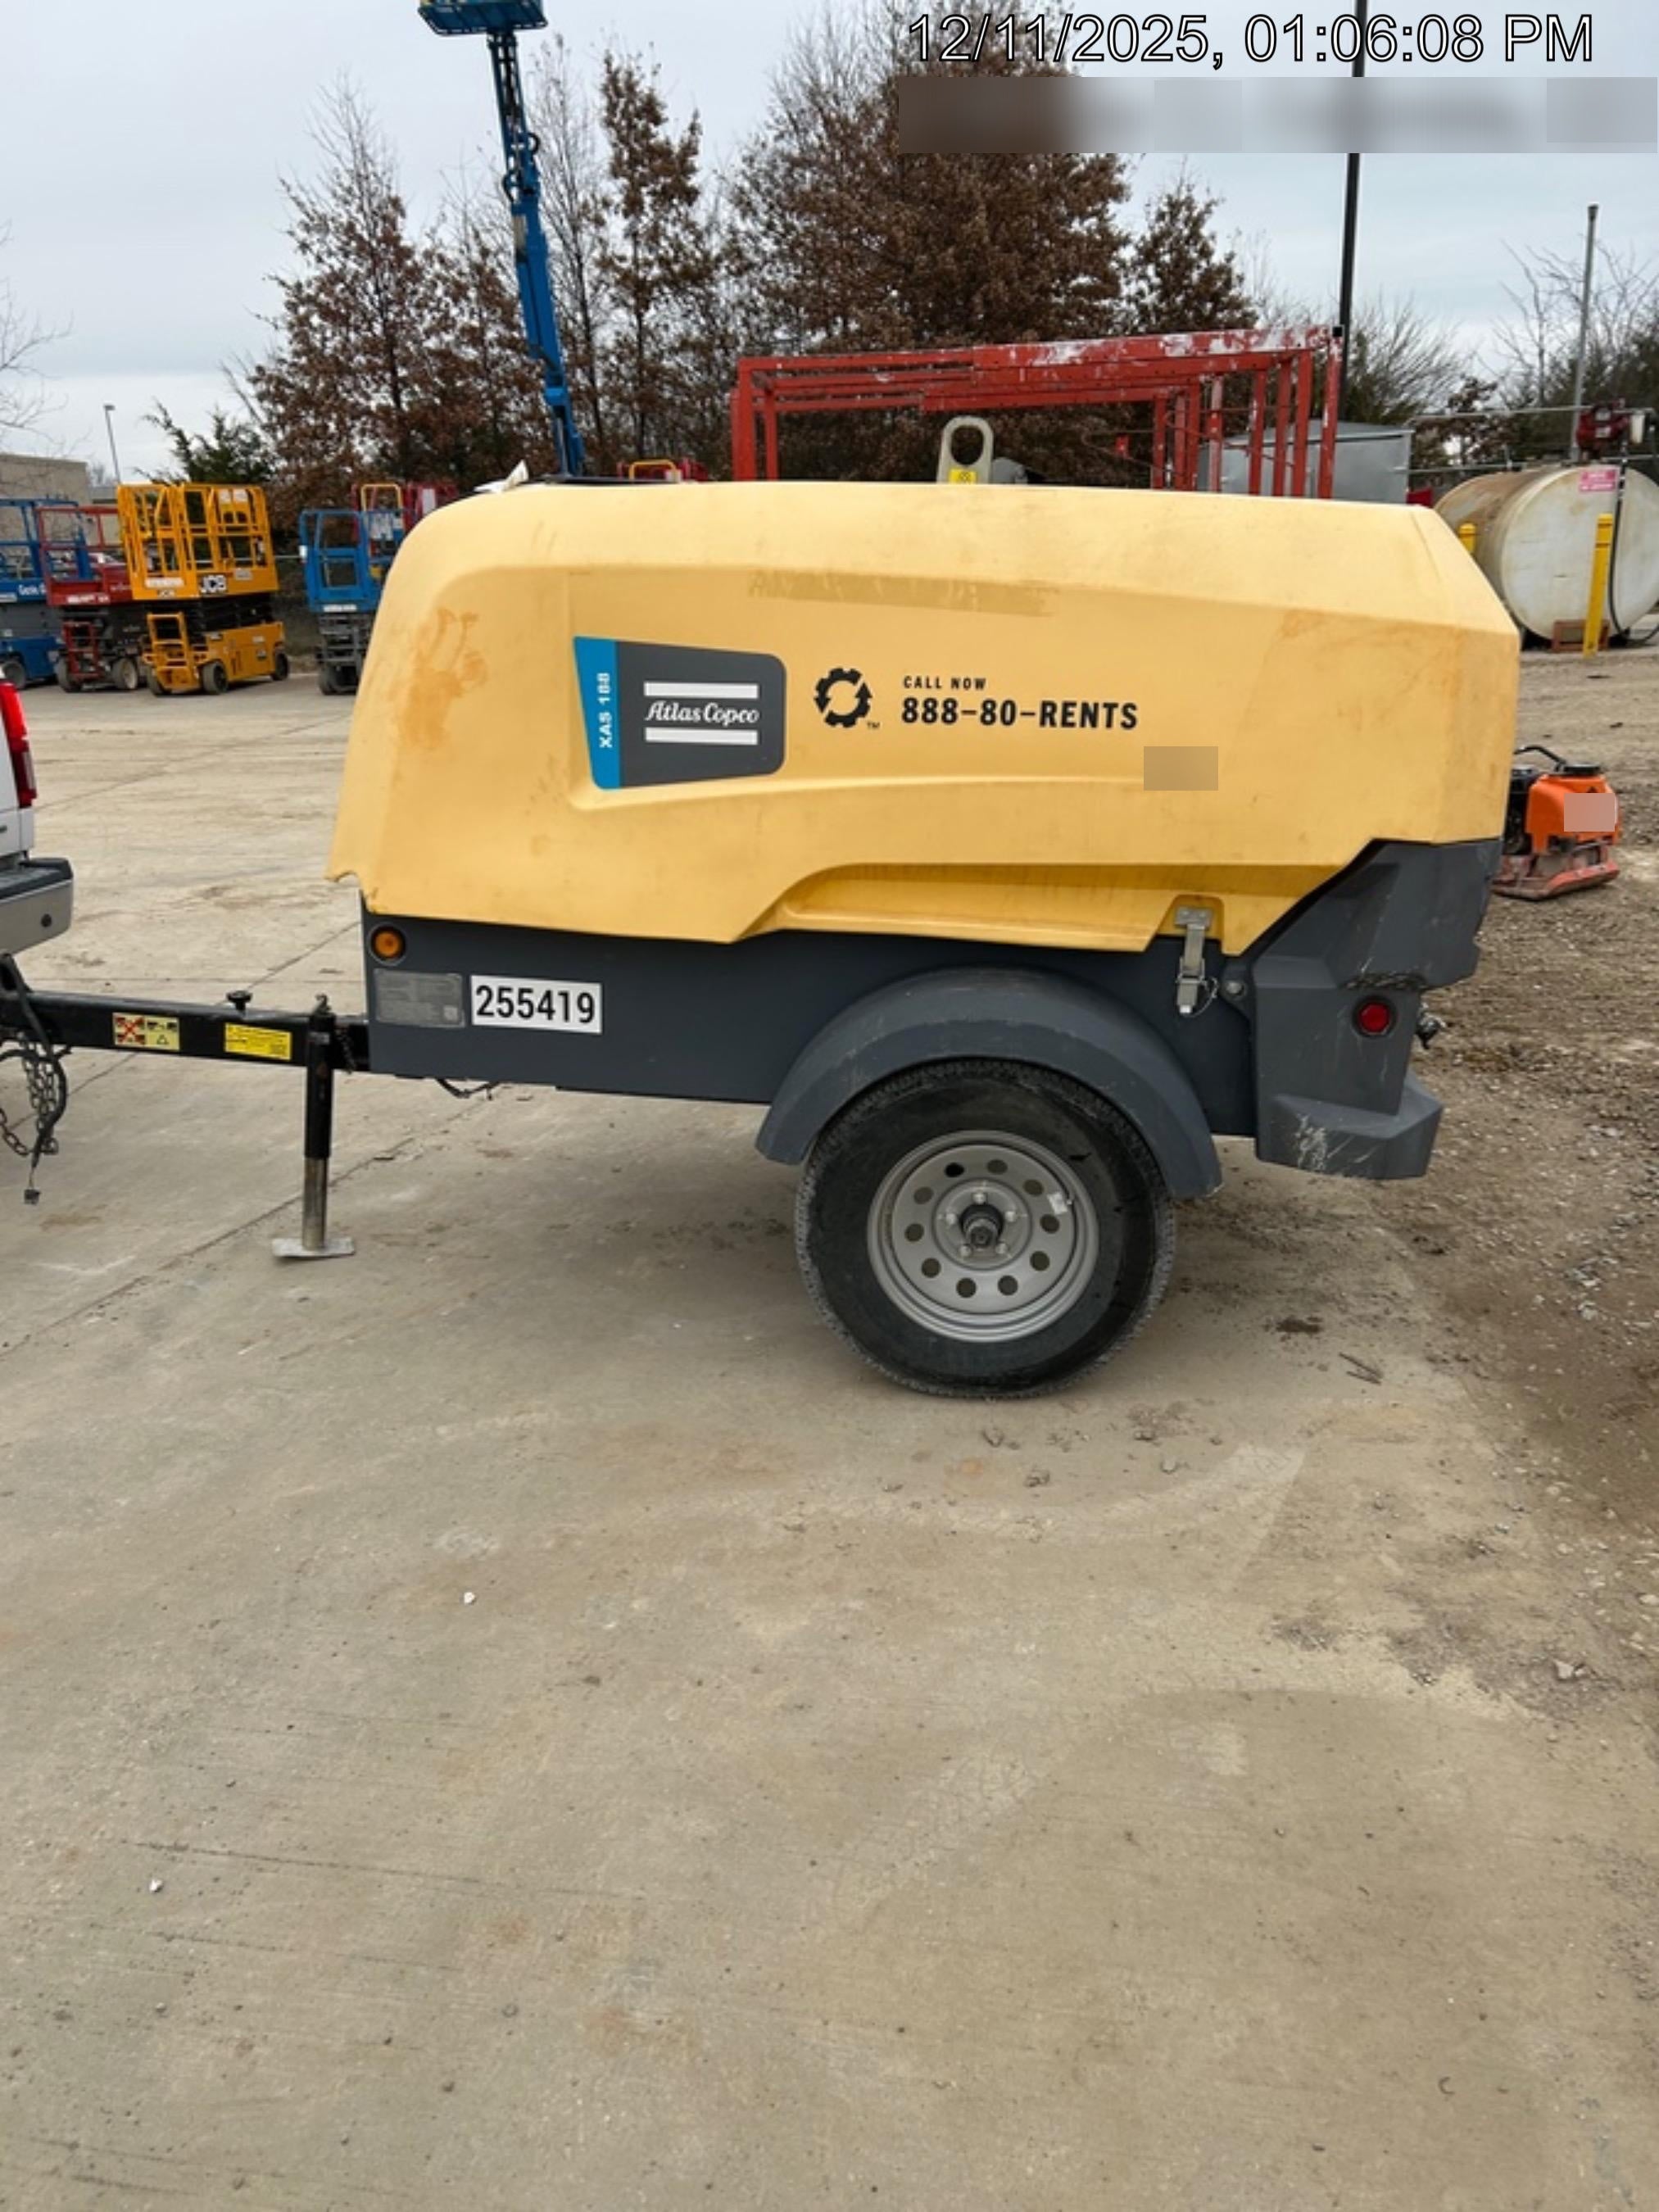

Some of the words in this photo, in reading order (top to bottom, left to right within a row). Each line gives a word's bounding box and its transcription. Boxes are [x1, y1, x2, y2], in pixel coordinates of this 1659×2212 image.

[903, 676, 942, 690] CALL
[950, 678, 986, 691] NOW
[599, 712, 613, 748] XAS
[645, 700, 701, 722] Atlas
[702, 702, 760, 728] Copco
[901, 696, 1138, 730] 888-80-RENTS
[475, 985, 596, 1024] 255419
